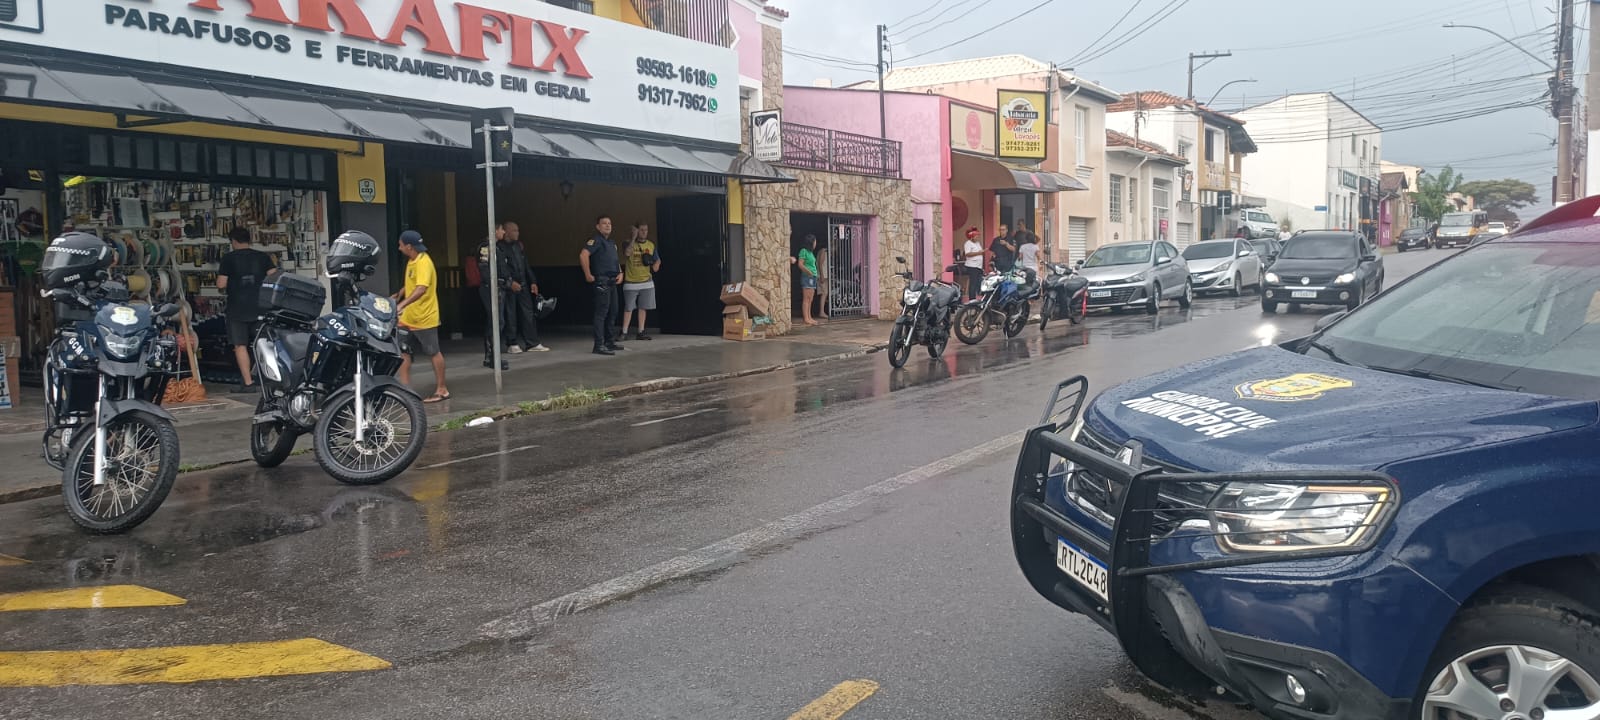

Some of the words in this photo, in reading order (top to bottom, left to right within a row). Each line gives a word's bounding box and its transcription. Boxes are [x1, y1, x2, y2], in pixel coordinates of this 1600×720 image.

[105, 4, 291, 53] PARAFUSOS
[305, 40, 322, 59] E
[337, 46, 494, 87] FERRAMENTAS
[501, 75, 527, 92] EM
[535, 81, 590, 102] GERAL
[636, 56, 707, 87] 99593-1618
[638, 83, 707, 112] 91317-7962
[69, 338, 84, 355] GCM
[1120, 396, 1249, 438] MUNICIPAL
[1214, 404, 1278, 429] CIVIL
[1061, 545, 1106, 593] RTL2C48
